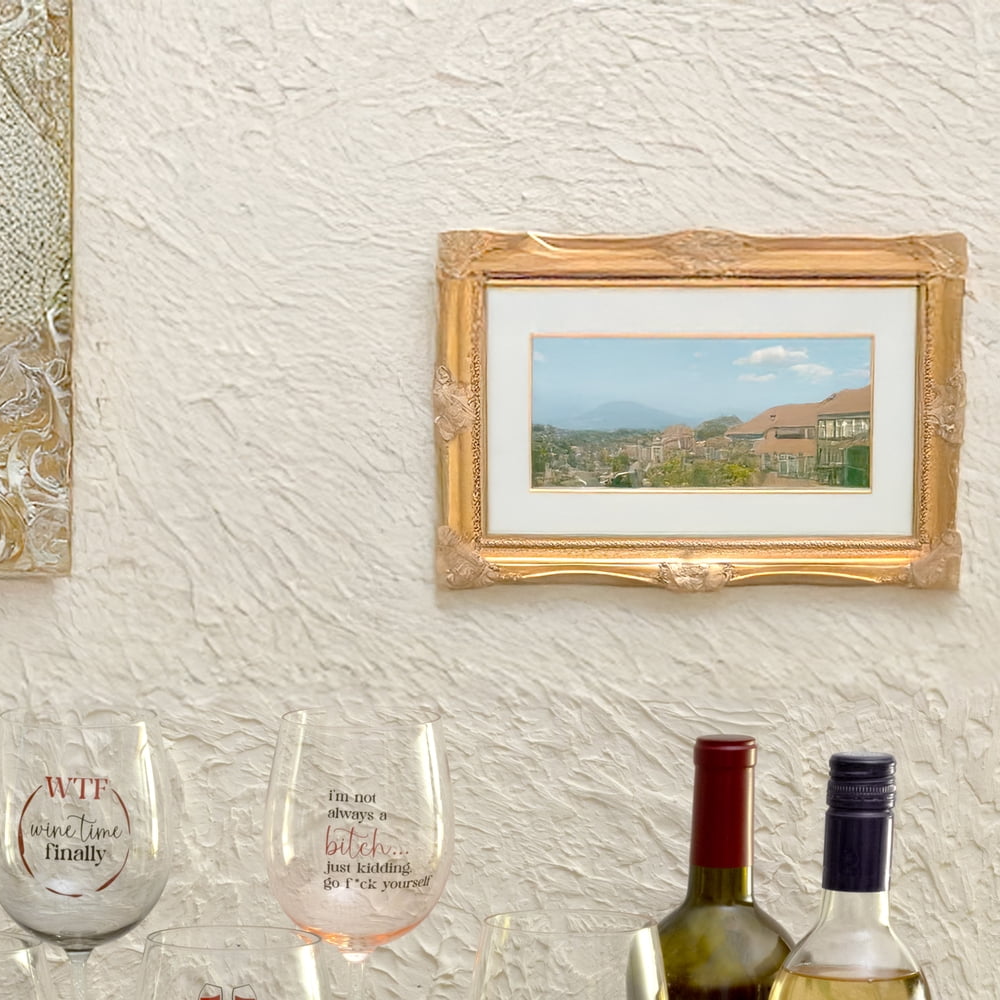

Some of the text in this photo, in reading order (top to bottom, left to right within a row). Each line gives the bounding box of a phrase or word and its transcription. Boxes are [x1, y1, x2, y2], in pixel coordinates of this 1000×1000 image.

[45, 776, 108, 799] WTF
[329, 789, 377, 803] i'm not
[328, 807, 387, 823] always a
[30, 813, 122, 842] wine time
[325, 825, 409, 859] bitch...
[45, 842, 106, 867] finally
[323, 861, 350, 874] just
[323, 877, 340, 890] go
[381, 875, 433, 892] yourself
